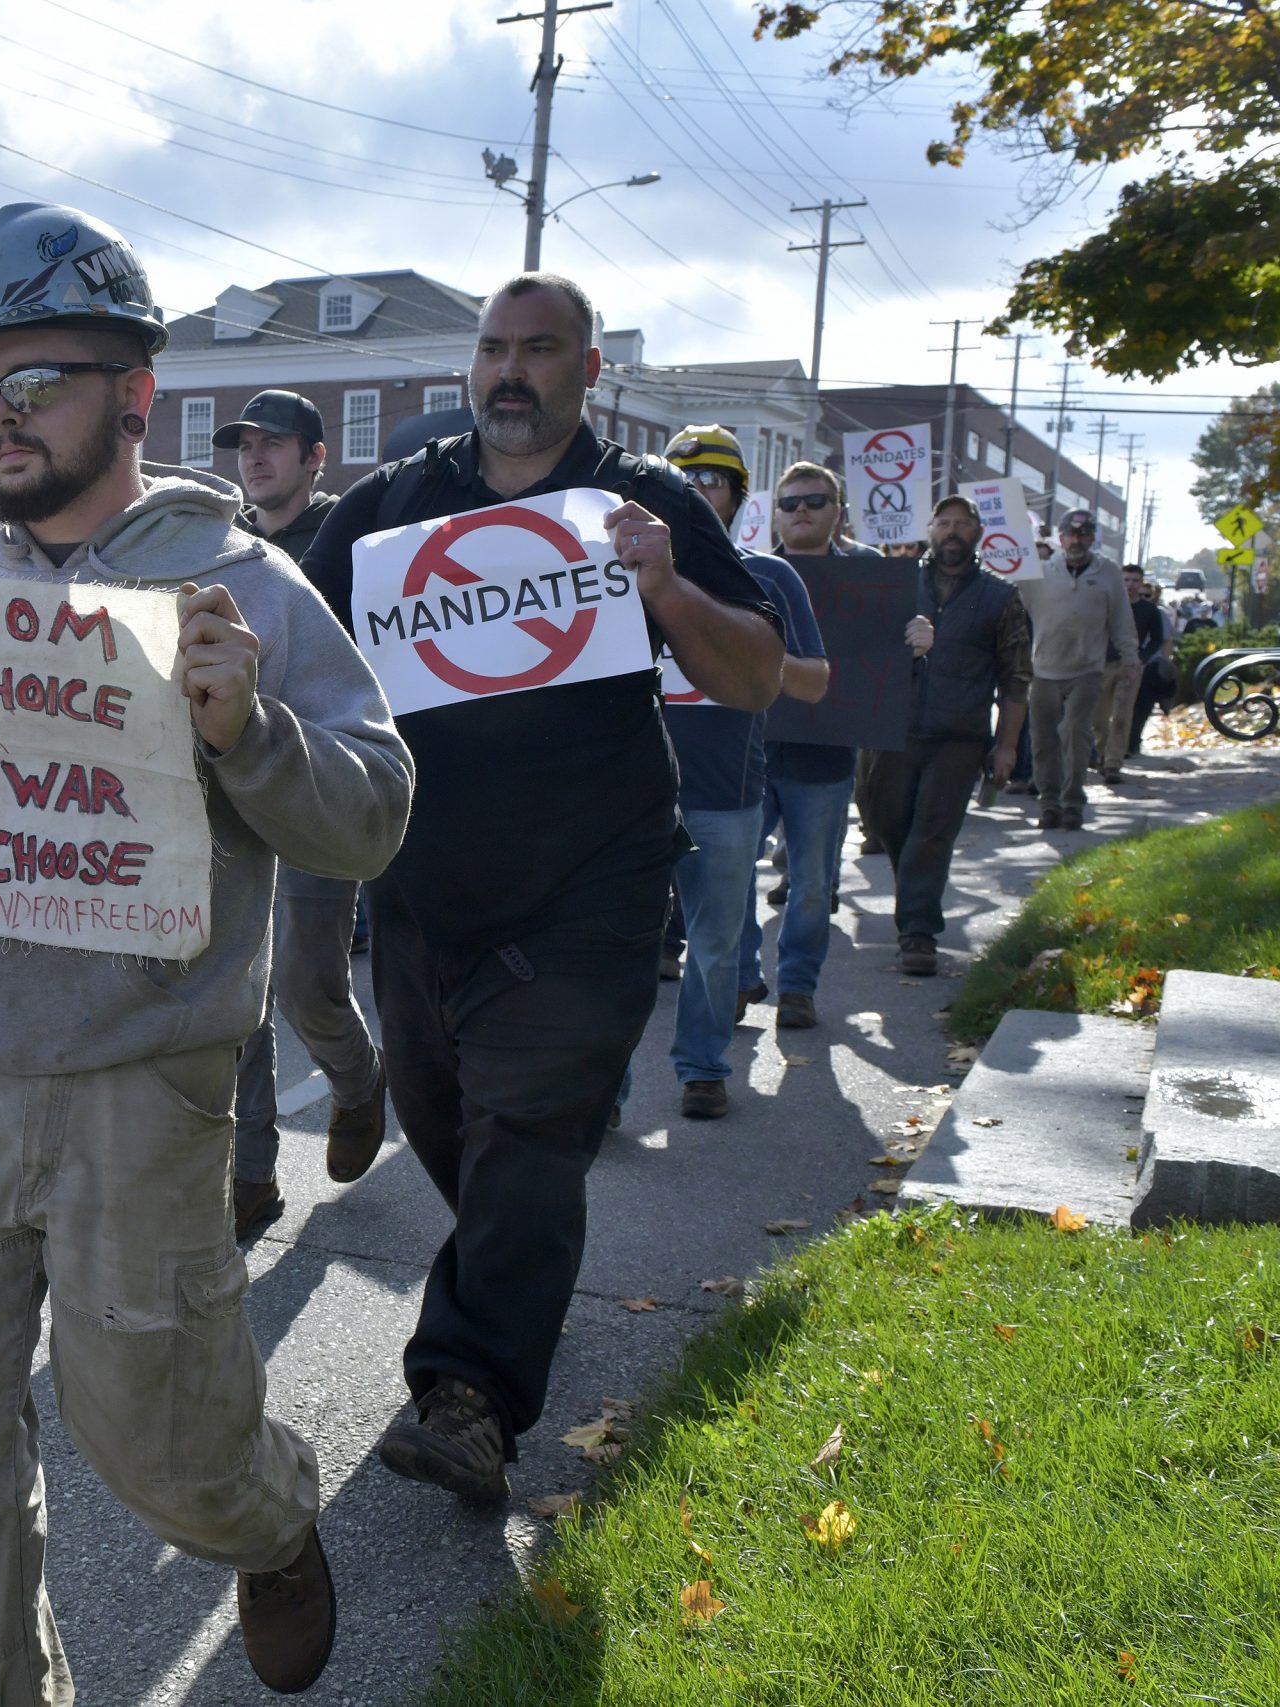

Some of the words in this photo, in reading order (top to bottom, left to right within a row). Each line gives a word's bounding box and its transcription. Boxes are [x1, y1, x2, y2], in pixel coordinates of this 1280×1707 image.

[851, 447, 926, 466] MANDATES
[982, 547, 1031, 560] ANDATES
[366, 560, 630, 646] MANDATES
[1, 760, 136, 822] WAR
